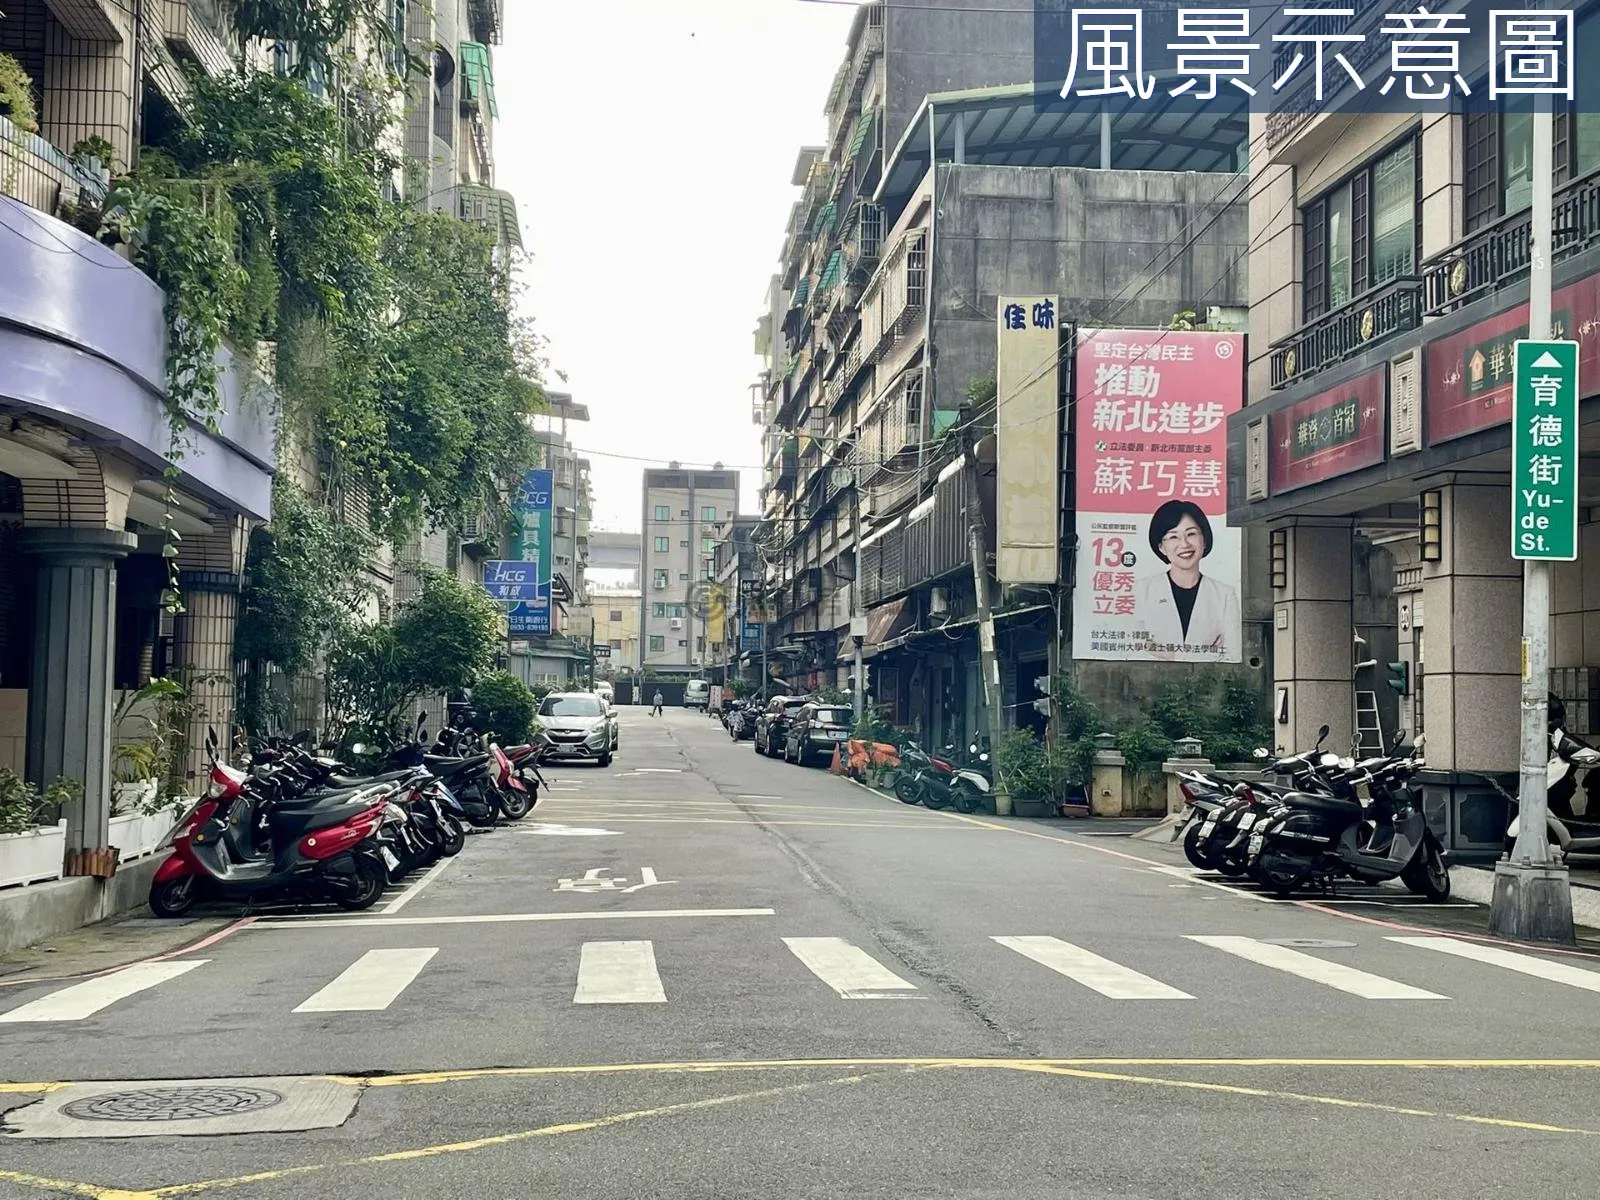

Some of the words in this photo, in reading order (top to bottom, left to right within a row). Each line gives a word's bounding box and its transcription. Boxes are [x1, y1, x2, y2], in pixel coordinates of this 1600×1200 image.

[1004, 298, 1055, 330] 佳味
[1093, 342, 1195, 361] 堅定台灣民主
[1094, 363, 1161, 398] 推動
[1092, 399, 1225, 434] 新北進步
[1529, 374, 1563, 486] 育德街
[1092, 457, 1222, 497] 蘇巧慧
[1521, 489, 1564, 508] Yu-
[1521, 513, 1549, 530] de
[1521, 532, 1550, 551] St.
[495, 563, 526, 581] HCG
[1092, 570, 1135, 592] 優秀
[499, 584, 521, 597] 和成
[1092, 594, 1136, 616] 立委
